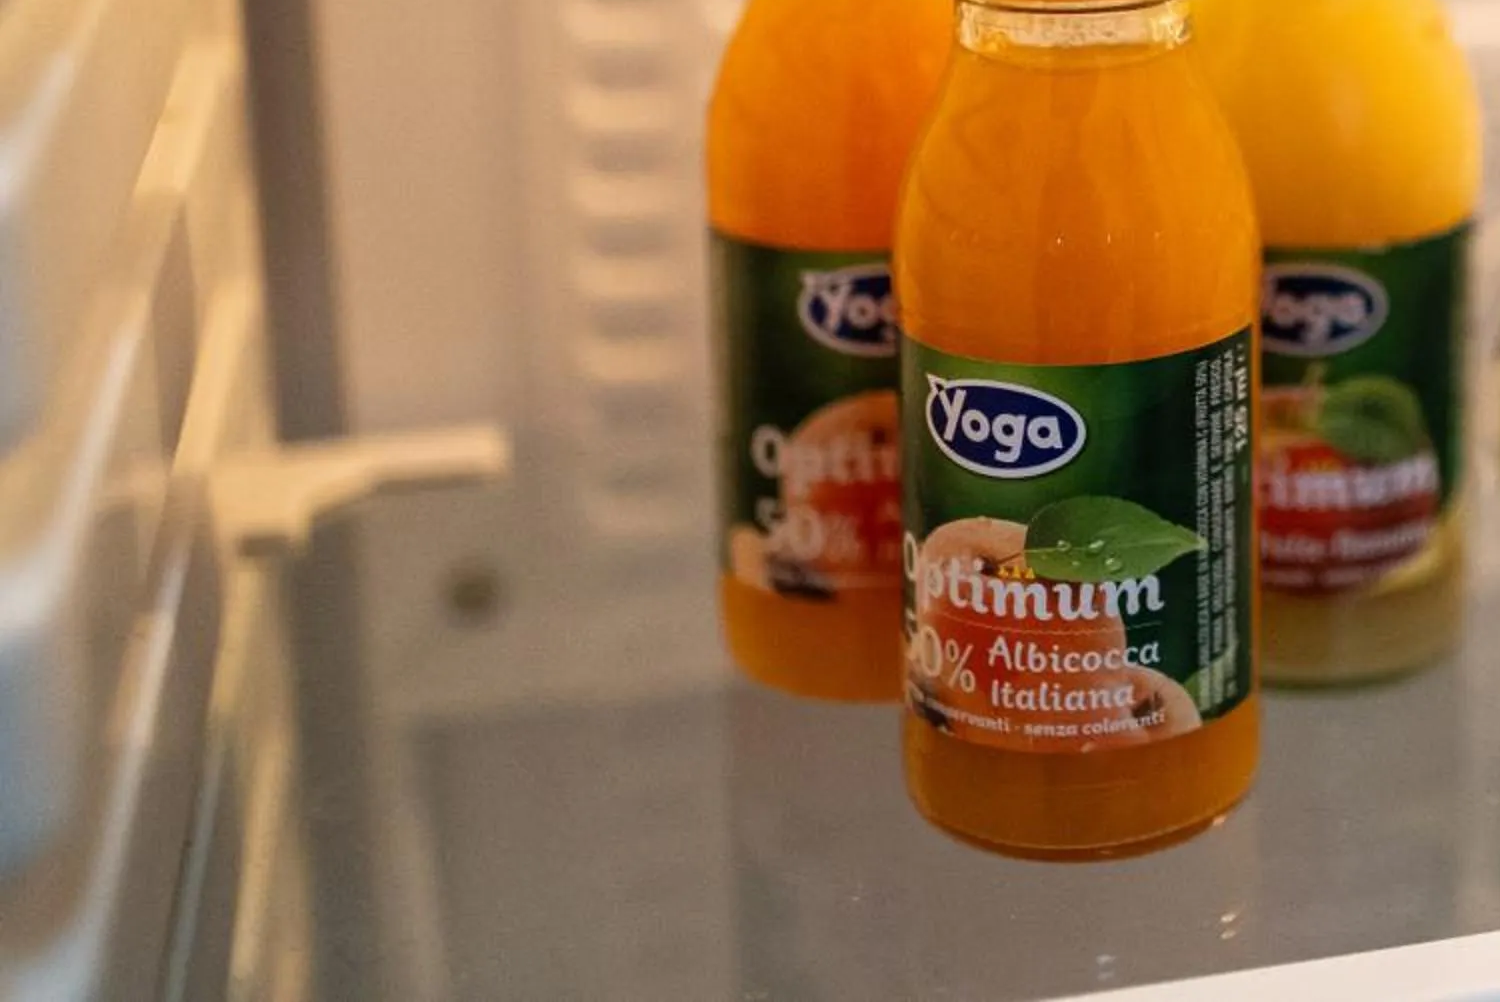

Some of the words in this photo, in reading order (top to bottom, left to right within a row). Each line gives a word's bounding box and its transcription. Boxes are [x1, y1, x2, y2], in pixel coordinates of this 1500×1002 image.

[937, 388, 1064, 463] Yoga
[904, 531, 1165, 622] Optimum
[988, 636, 1161, 674] Albicocca
[990, 679, 1137, 712] Italiana
[1023, 722, 1078, 737] senza
[1081, 709, 1166, 736] coloranti
